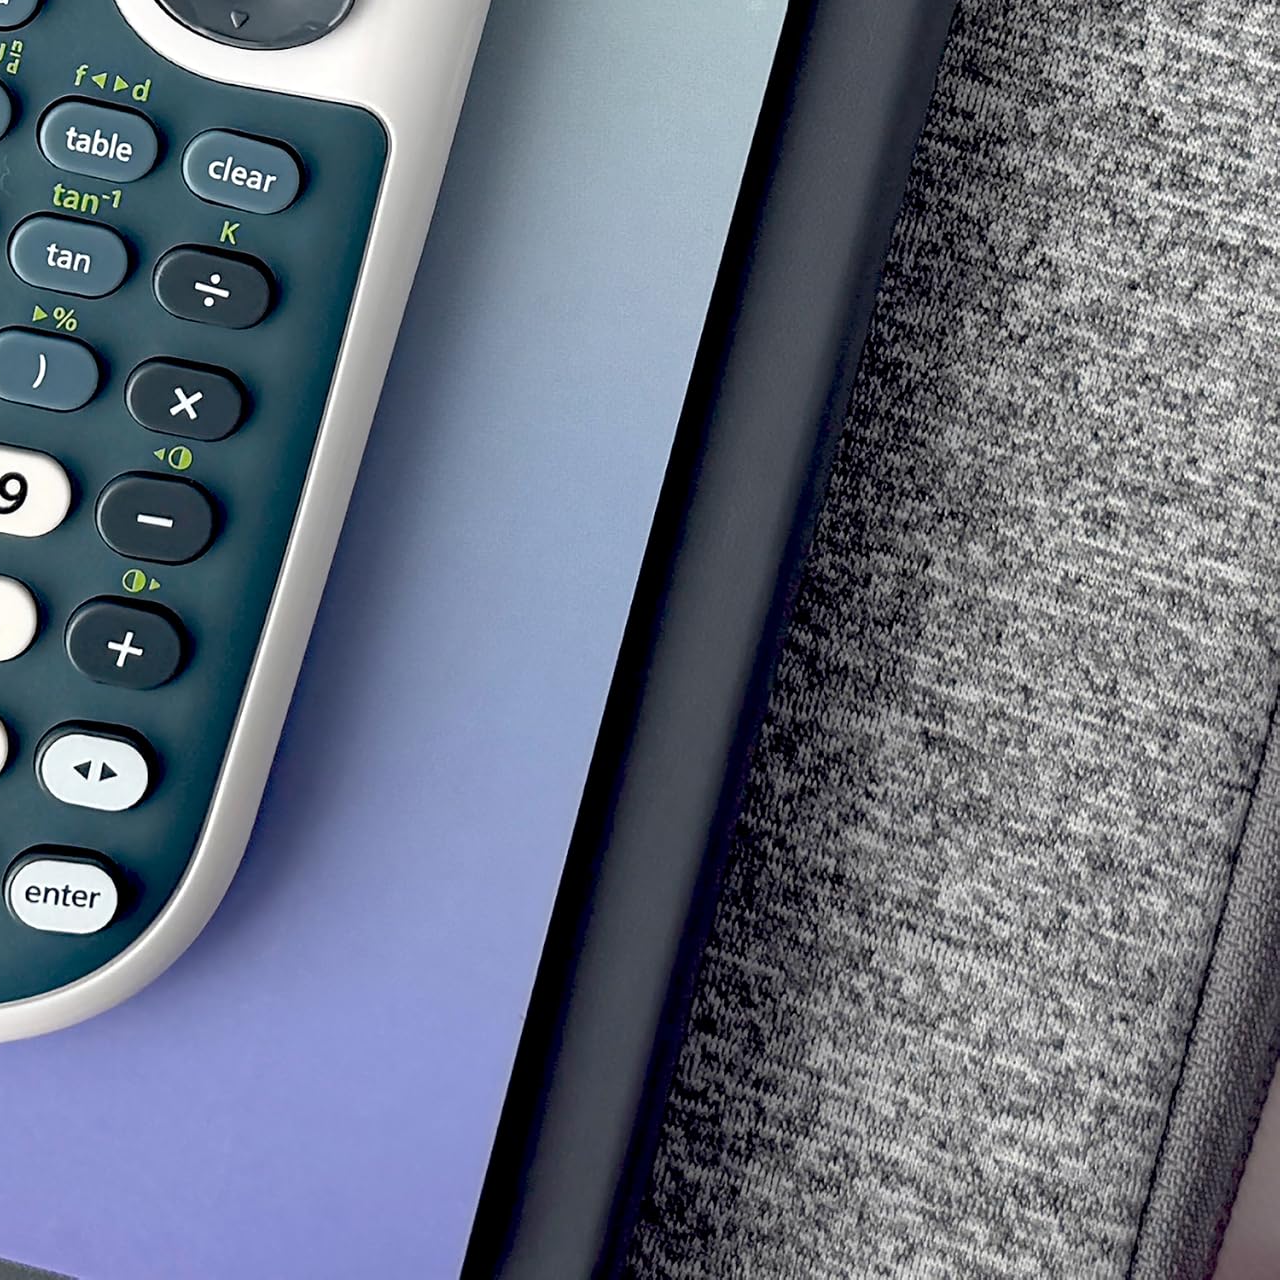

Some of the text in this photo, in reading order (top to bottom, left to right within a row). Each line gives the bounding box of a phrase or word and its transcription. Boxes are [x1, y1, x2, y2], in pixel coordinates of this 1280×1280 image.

[65, 127, 133, 162] table
[207, 156, 277, 193] clear
[219, 221, 240, 245] K
[46, 242, 91, 274] tan
[24, 883, 101, 910] enter
